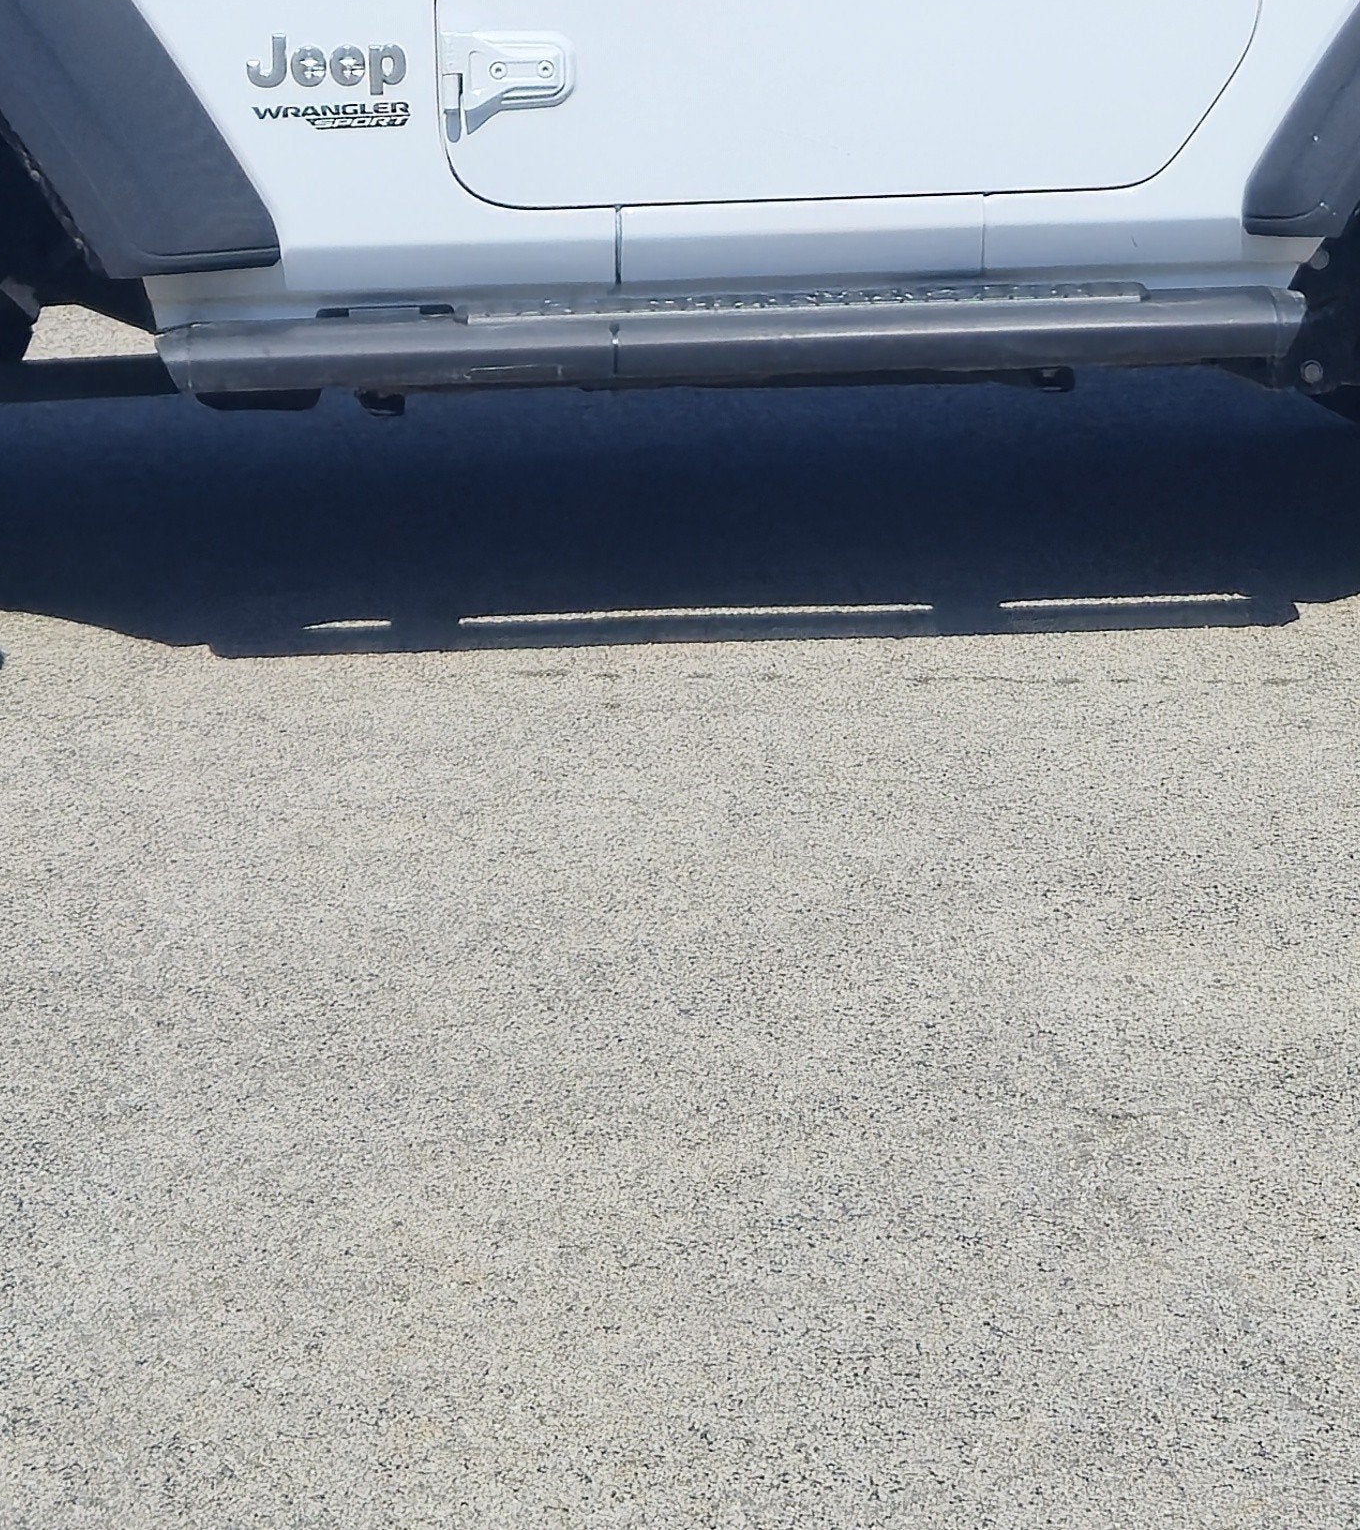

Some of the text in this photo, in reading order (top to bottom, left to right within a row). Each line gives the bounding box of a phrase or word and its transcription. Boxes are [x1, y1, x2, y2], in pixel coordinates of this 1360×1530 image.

[246, 32, 407, 96] Jeep
[251, 101, 411, 120] WRANGLER
[312, 115, 409, 129] SPORT
